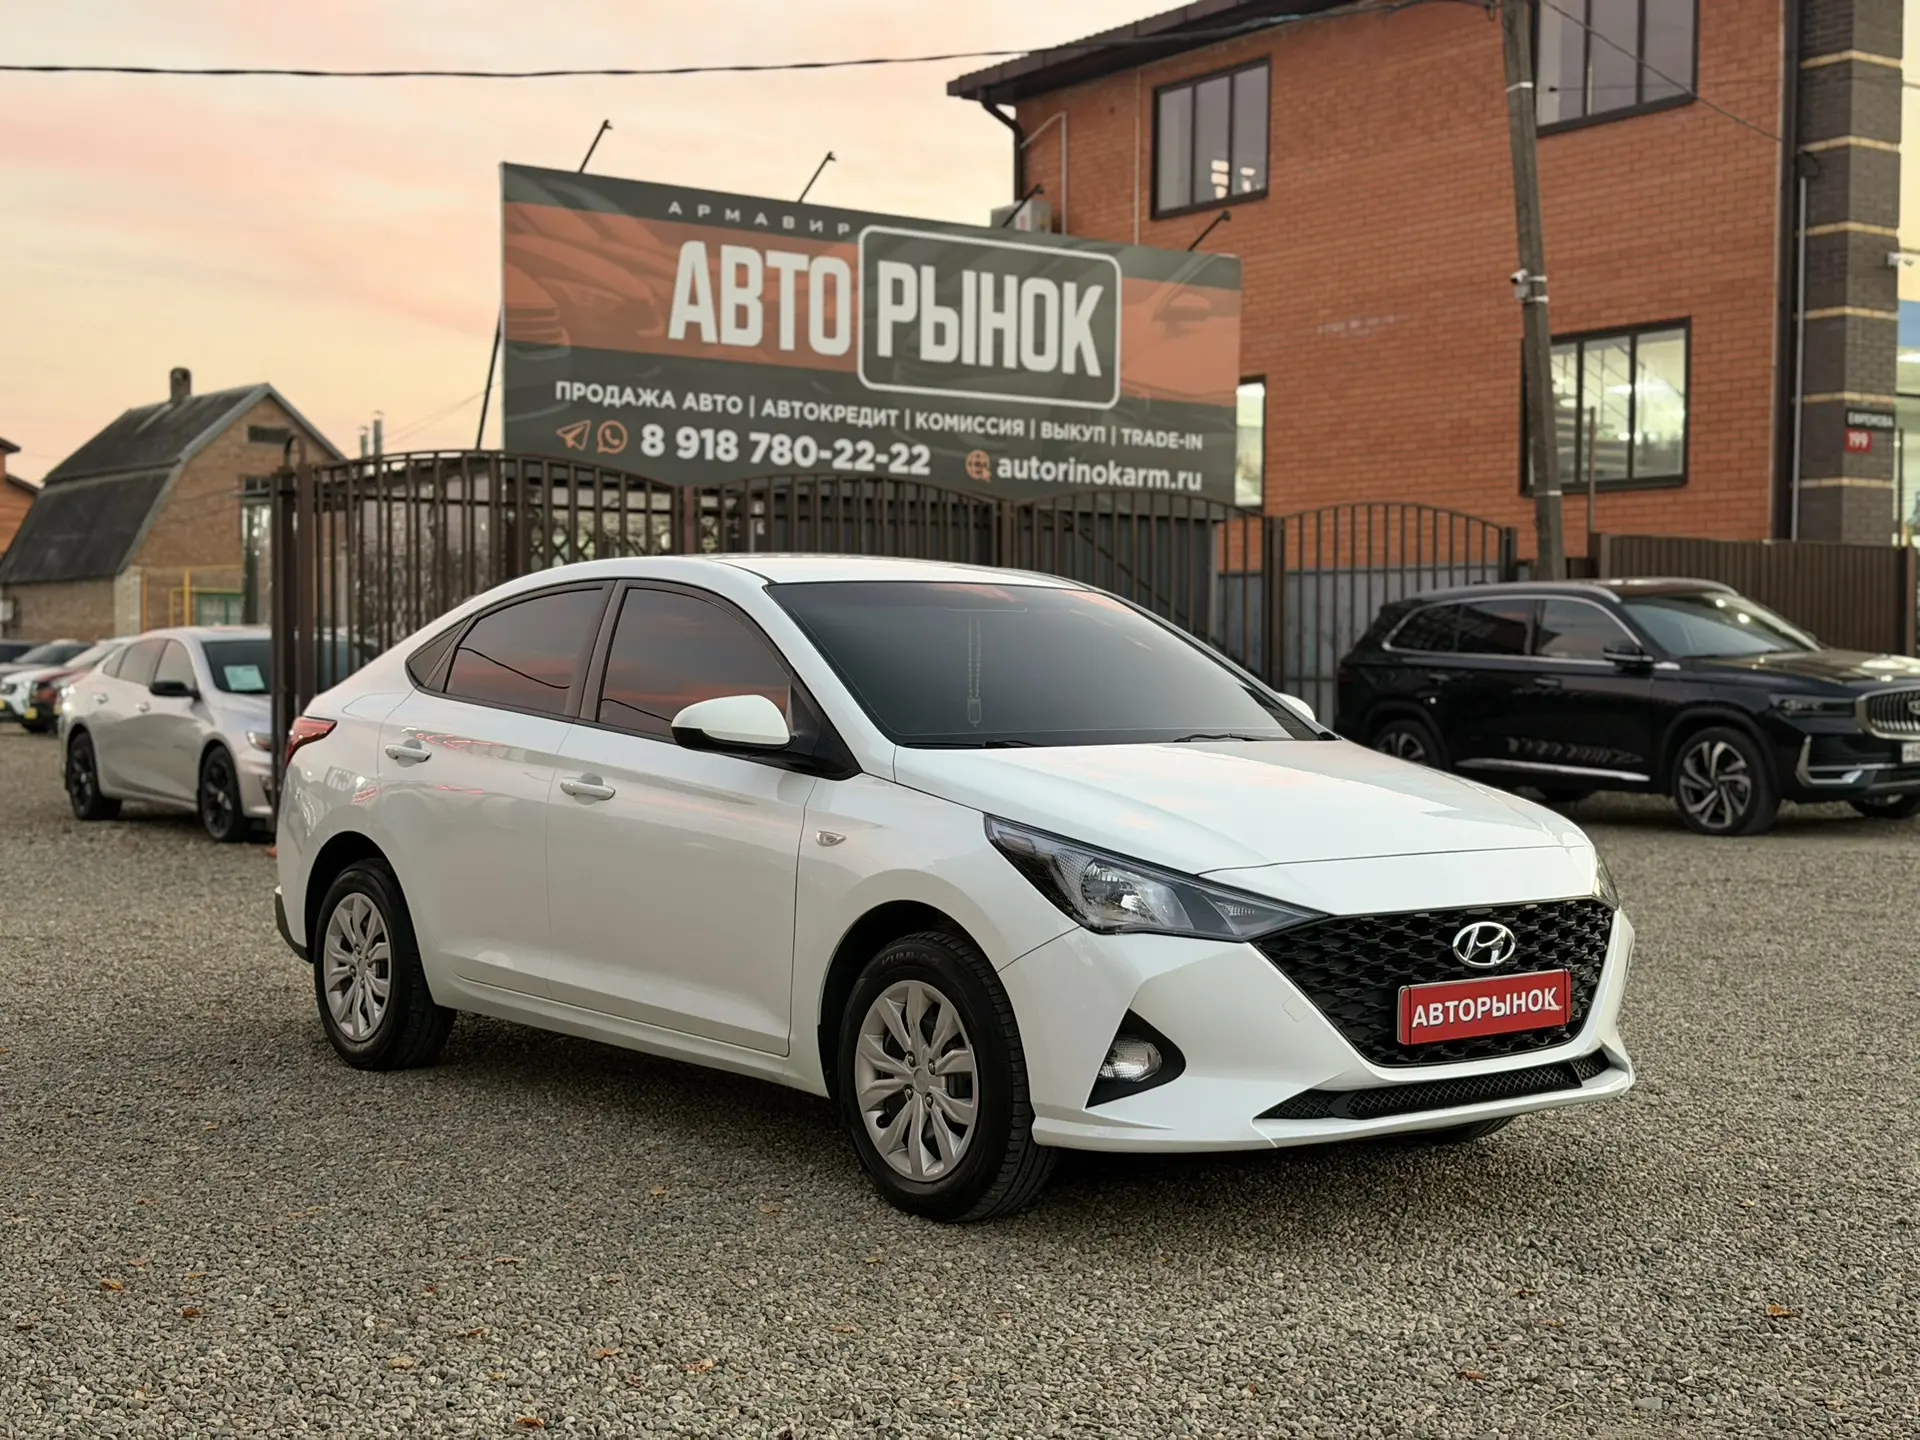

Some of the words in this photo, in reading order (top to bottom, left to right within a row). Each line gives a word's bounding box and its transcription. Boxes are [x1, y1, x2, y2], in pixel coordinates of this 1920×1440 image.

[668, 201, 851, 236] АРМАВИР
[667, 240, 851, 356] АВТО
[877, 259, 1104, 377] РЫНОК
[555, 380, 676, 410] ПРОДАЖА
[682, 393, 743, 414] АВТО
[761, 398, 899, 428] АВТОКРЕДИТ
[915, 411, 1025, 437] КОМИССИЯ
[1040, 421, 1106, 443] ВЫКУП
[1121, 428, 1203, 450] TRADE-IN
[641, 423, 665, 457] 8
[675, 426, 739, 462] 918
[748, 431, 931, 476] 780-22-22
[997, 456, 1203, 491] autorinokarm.ru
[1411, 986, 1560, 1029] АВТОРЫНОК
